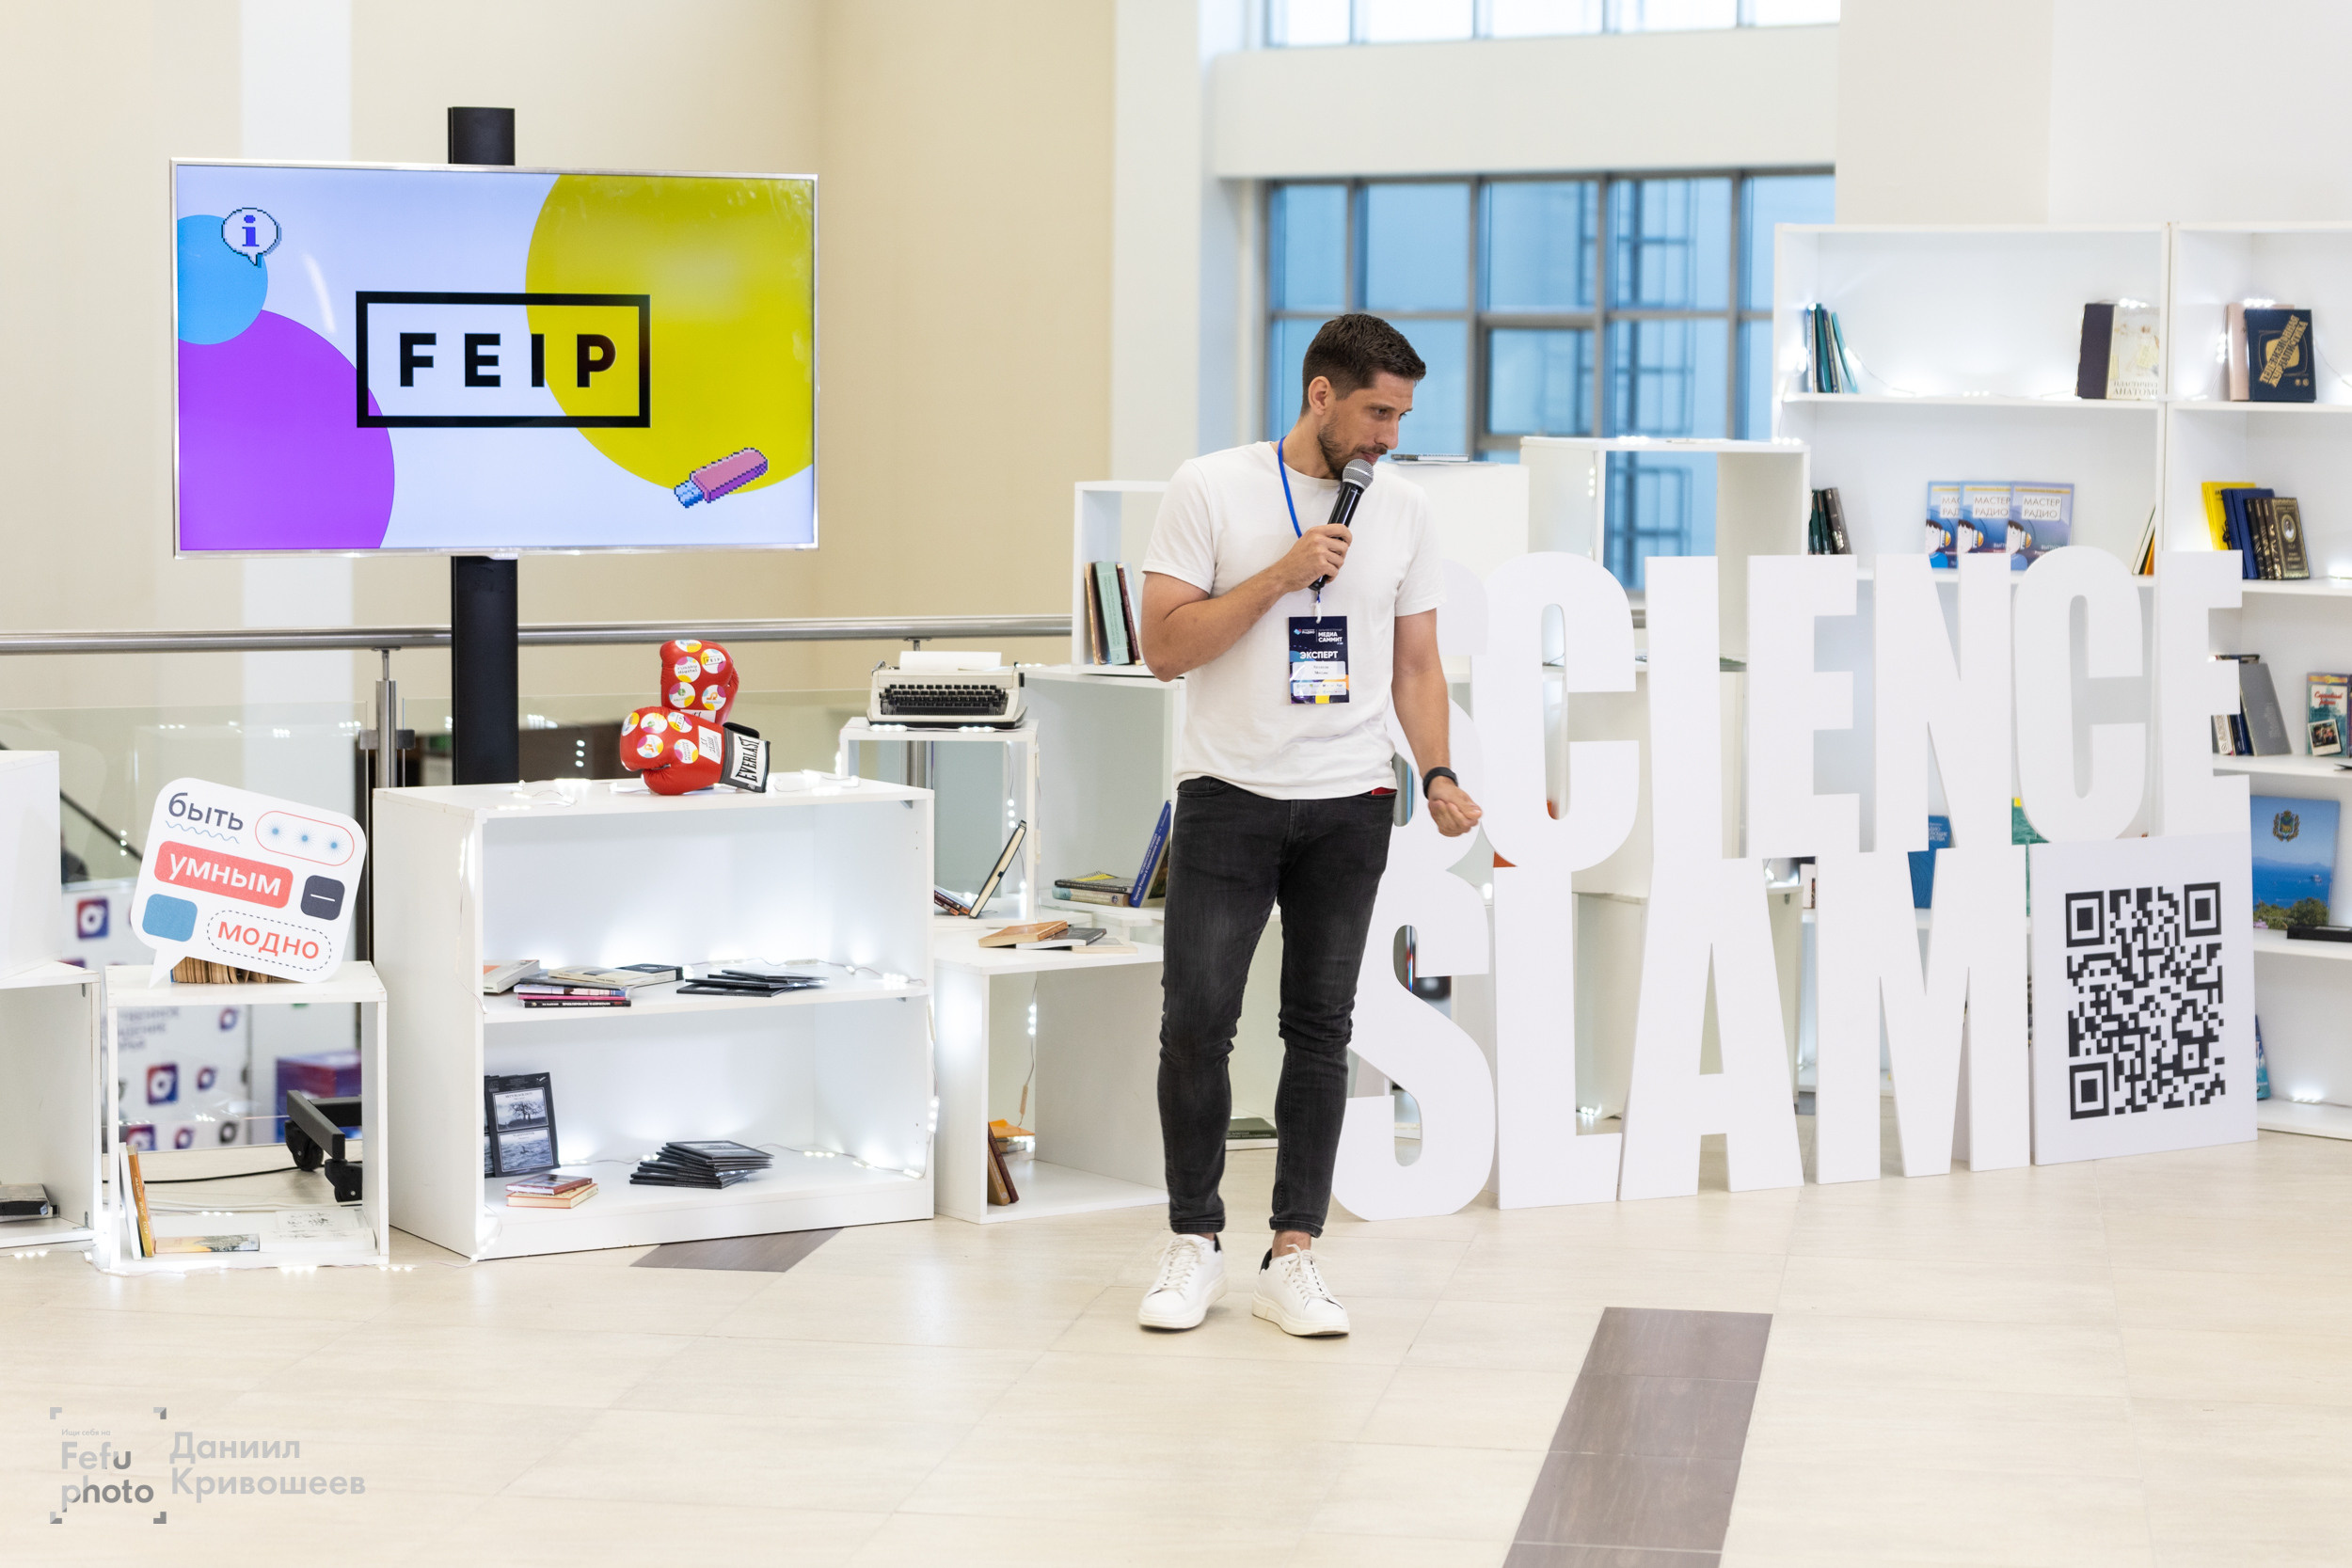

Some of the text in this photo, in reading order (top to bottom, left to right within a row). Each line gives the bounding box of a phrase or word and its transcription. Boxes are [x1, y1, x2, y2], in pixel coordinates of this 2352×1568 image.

[399, 332, 617, 388] FEIP
[1974, 496, 2011, 505] МАСТЕР
[1975, 508, 2009, 518] РАДИО
[2024, 498, 2061, 507] МАСТЕР
[2024, 509, 2058, 519] РАДИО
[1299, 651, 1339, 659] ЭКСПЕРТ
[735, 736, 761, 783] EVERLAST
[167, 791, 245, 832] быть
[168, 852, 283, 897] умным
[216, 921, 320, 960] модно
[1332, 843, 2030, 1221] SLAM
